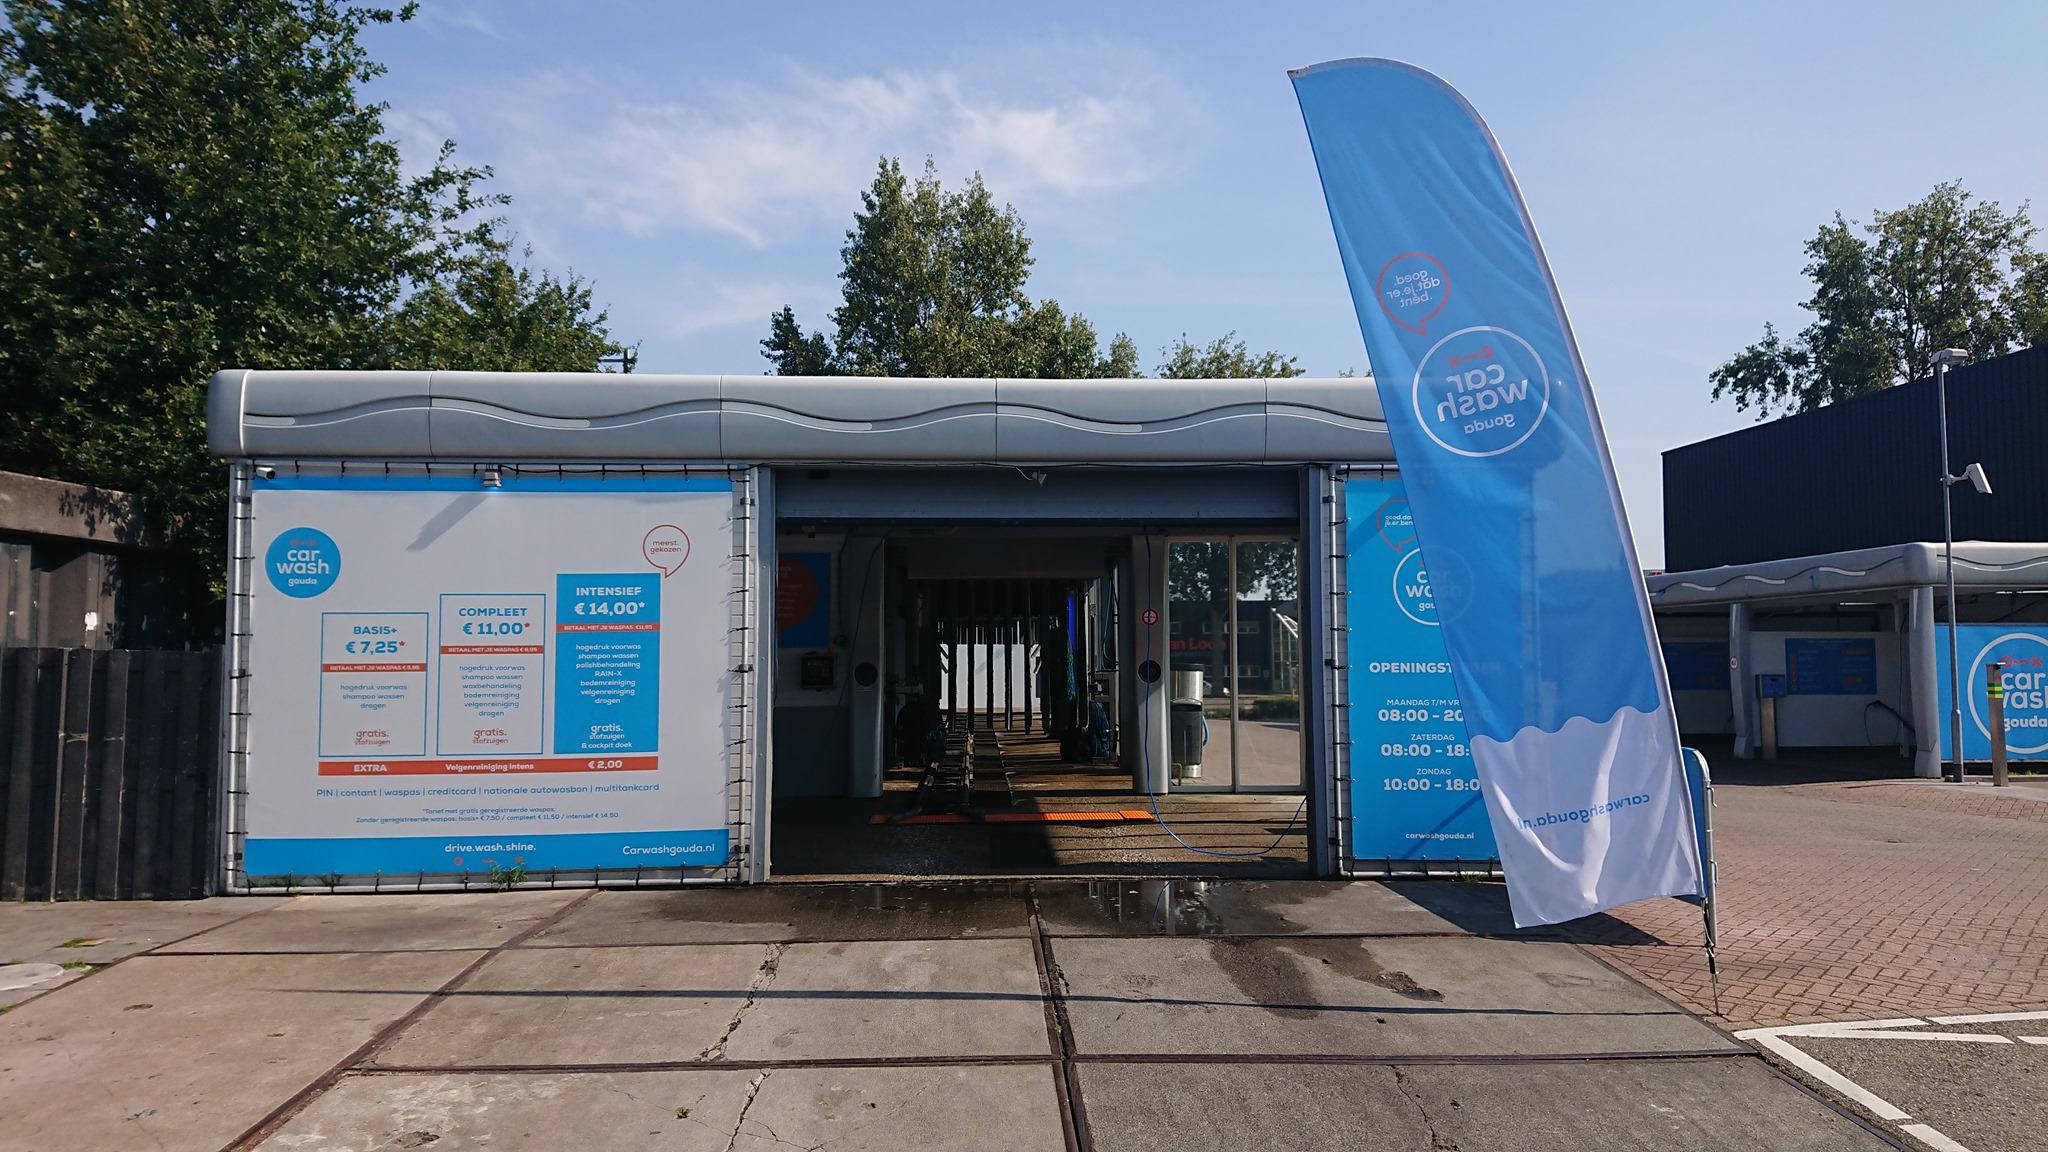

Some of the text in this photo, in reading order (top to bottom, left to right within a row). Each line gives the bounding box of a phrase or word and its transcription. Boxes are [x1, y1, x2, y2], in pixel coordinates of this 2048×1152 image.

[287, 550, 320, 561] car
[650, 546, 682, 555] gekozen
[276, 560, 330, 575] wash
[288, 578, 317, 587] gouda
[576, 587, 642, 596] INTENSIEF
[458, 608, 528, 617] COMPLEET
[574, 602, 585, 615] €
[353, 626, 397, 635] BASIS+
[462, 622, 473, 635] €
[345, 641, 356, 654] €
[576, 644, 609, 652] hogedruk
[459, 665, 493, 673] hogedruk
[1369, 662, 1453, 673] OPENINGST
[2001, 672, 2046, 690] car
[2003, 685, 2048, 709] as
[464, 701, 520, 709] velgenreiniging
[478, 710, 505, 718] drogen
[1378, 709, 1428, 722] 08:00
[591, 723, 624, 734] gratis.
[2004, 715, 2048, 732] gouda
[356, 729, 389, 741] gratis.
[474, 728, 507, 740] gratis.
[589, 733, 625, 741] stofzuigen
[354, 739, 391, 747] stofzuigen
[588, 742, 614, 750] cockpit
[1381, 744, 1431, 757] 08:00
[1446, 744, 1470, 757] 18:
[353, 764, 388, 772] EXTRA
[445, 764, 508, 773] Velgenreiniging
[588, 760, 595, 769] €
[597, 760, 623, 770] 2,00
[316, 789, 333, 797] PIN
[340, 789, 377, 797] contant
[427, 787, 476, 796] creditcard
[484, 786, 528, 795] nationale
[530, 785, 588, 794] autowasbon
[595, 783, 660, 792] multitankcard
[1383, 778, 1430, 791] 10:00
[1445, 778, 1481, 791] 18:0
[480, 807, 528, 815] geregistreerde
[1405, 832, 1474, 841] carwashgouda.nl
[444, 842, 537, 852] drive.wash.shine.
[622, 844, 715, 857] Carwashgouda.nl
